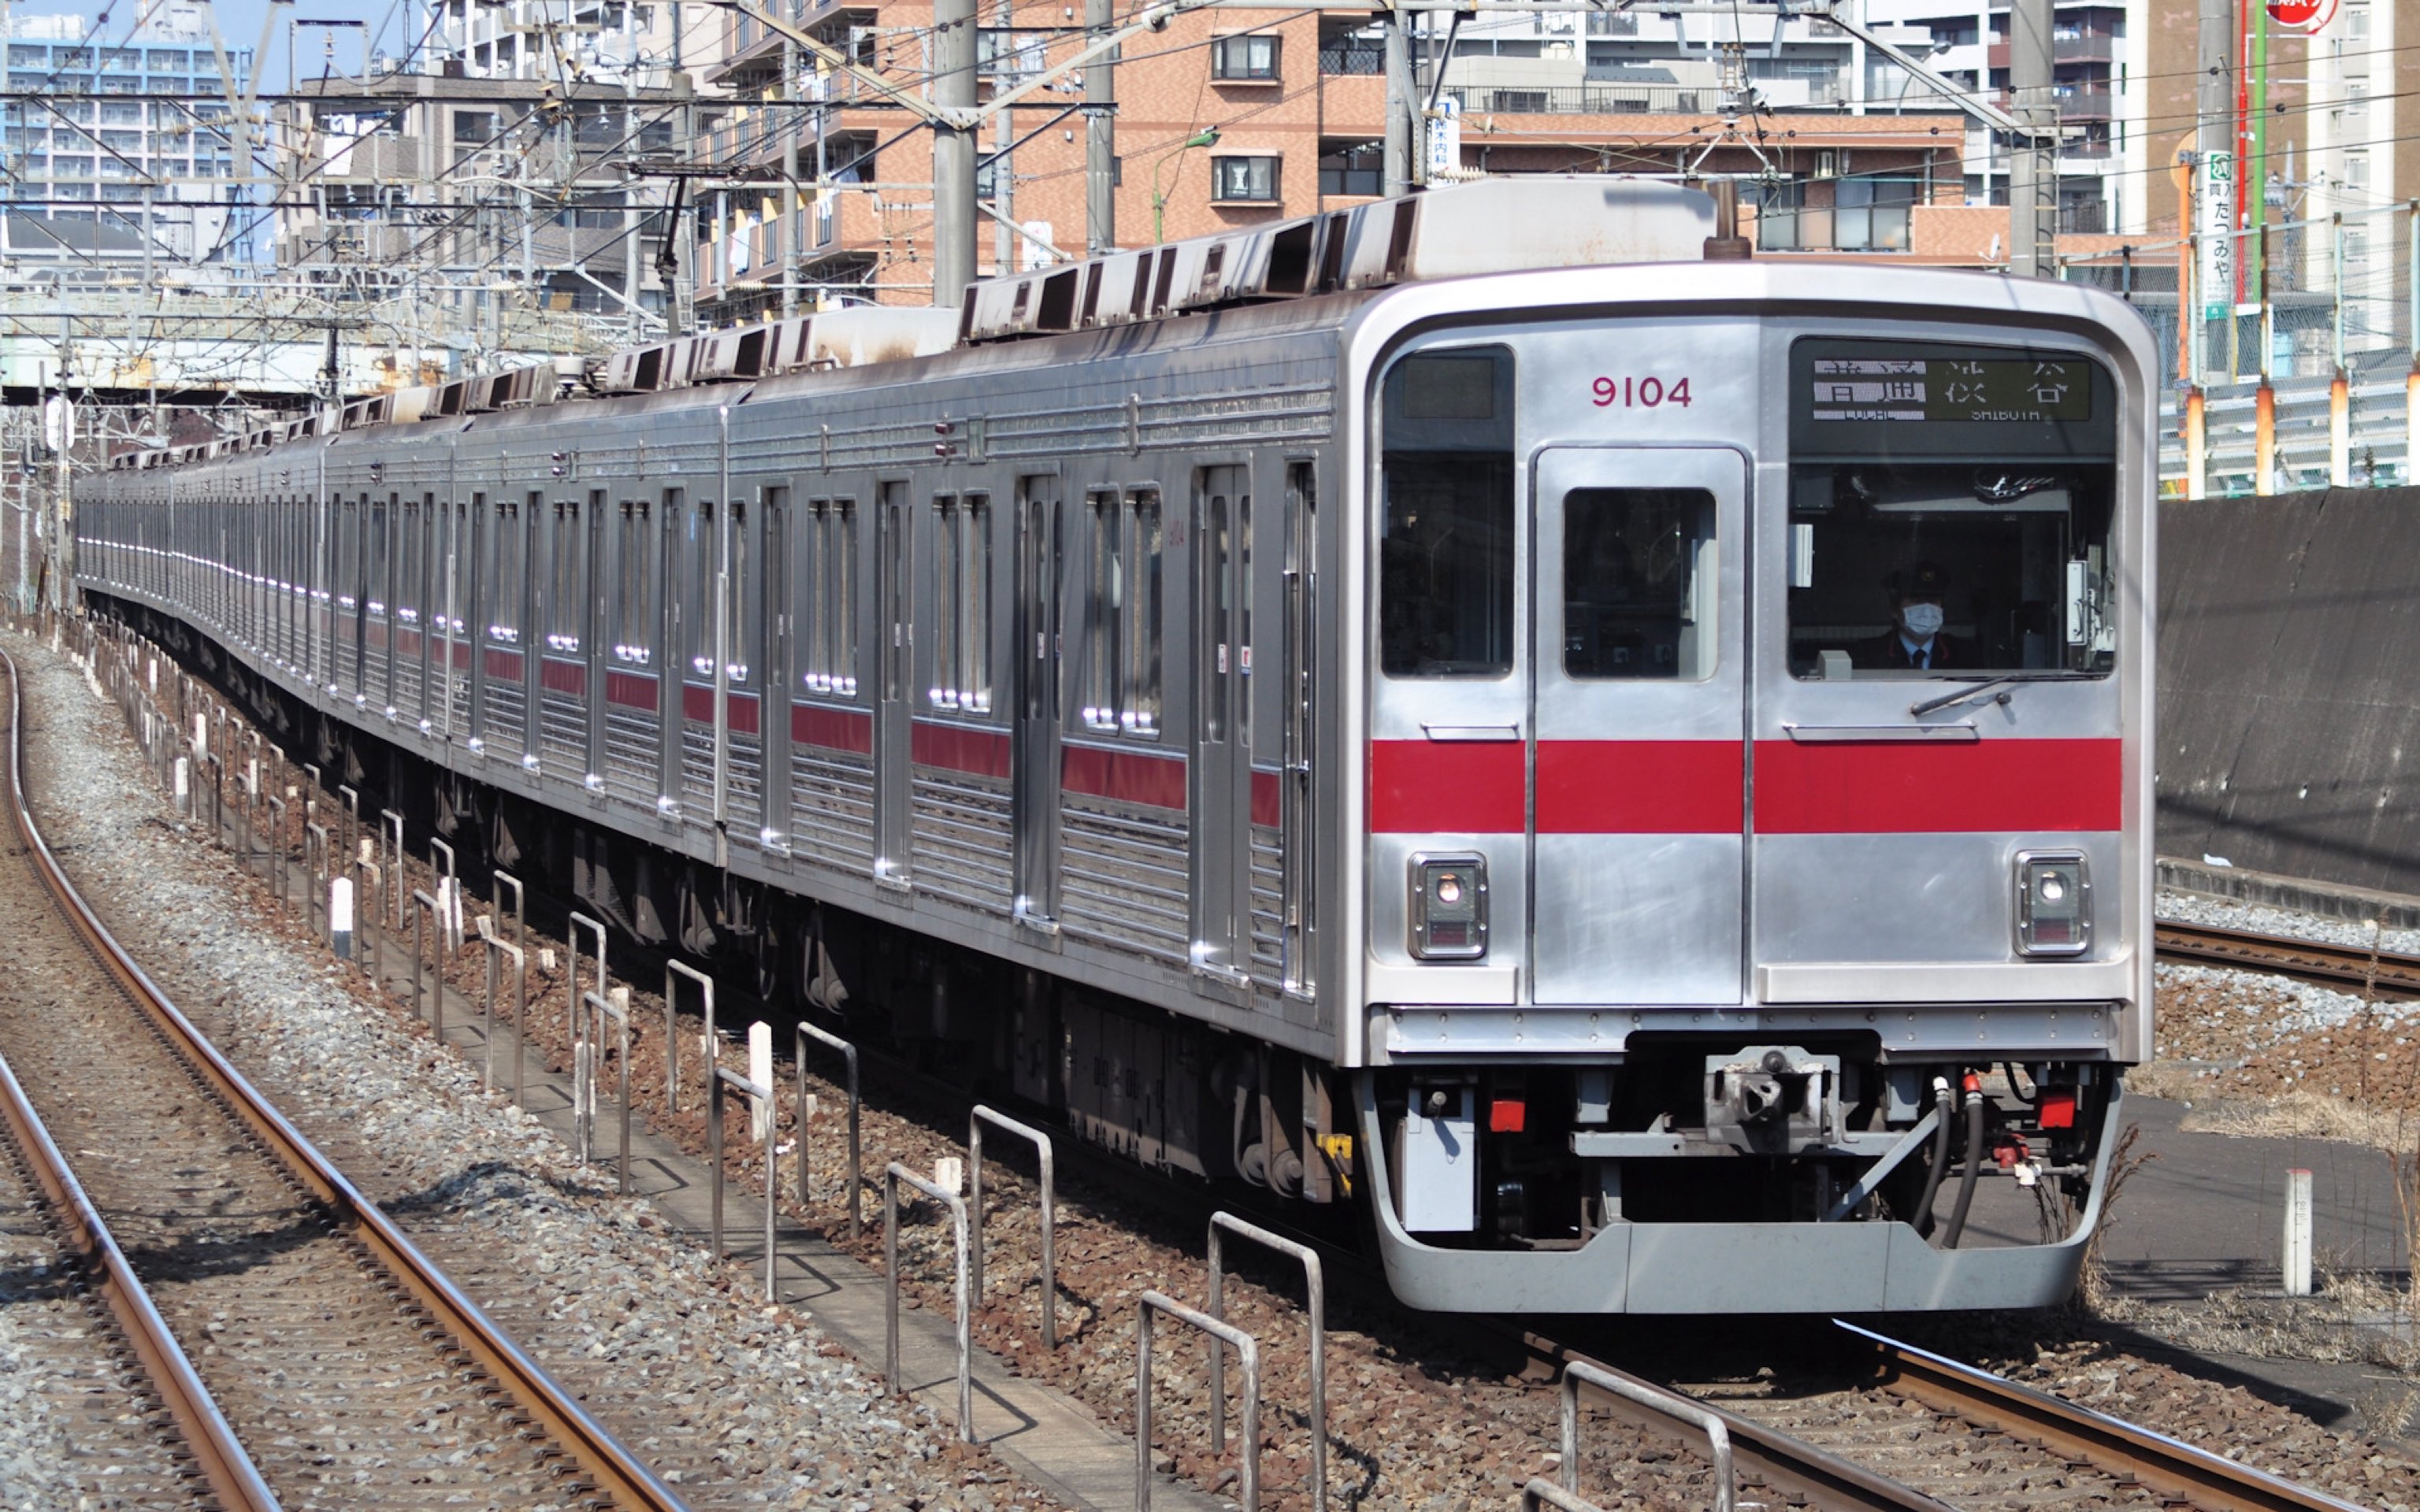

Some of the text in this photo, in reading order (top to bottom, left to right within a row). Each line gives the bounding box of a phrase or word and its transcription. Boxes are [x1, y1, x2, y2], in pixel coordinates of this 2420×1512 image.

[2214, 202, 2229, 283] たつみや
[1592, 376, 1692, 407] 9104
